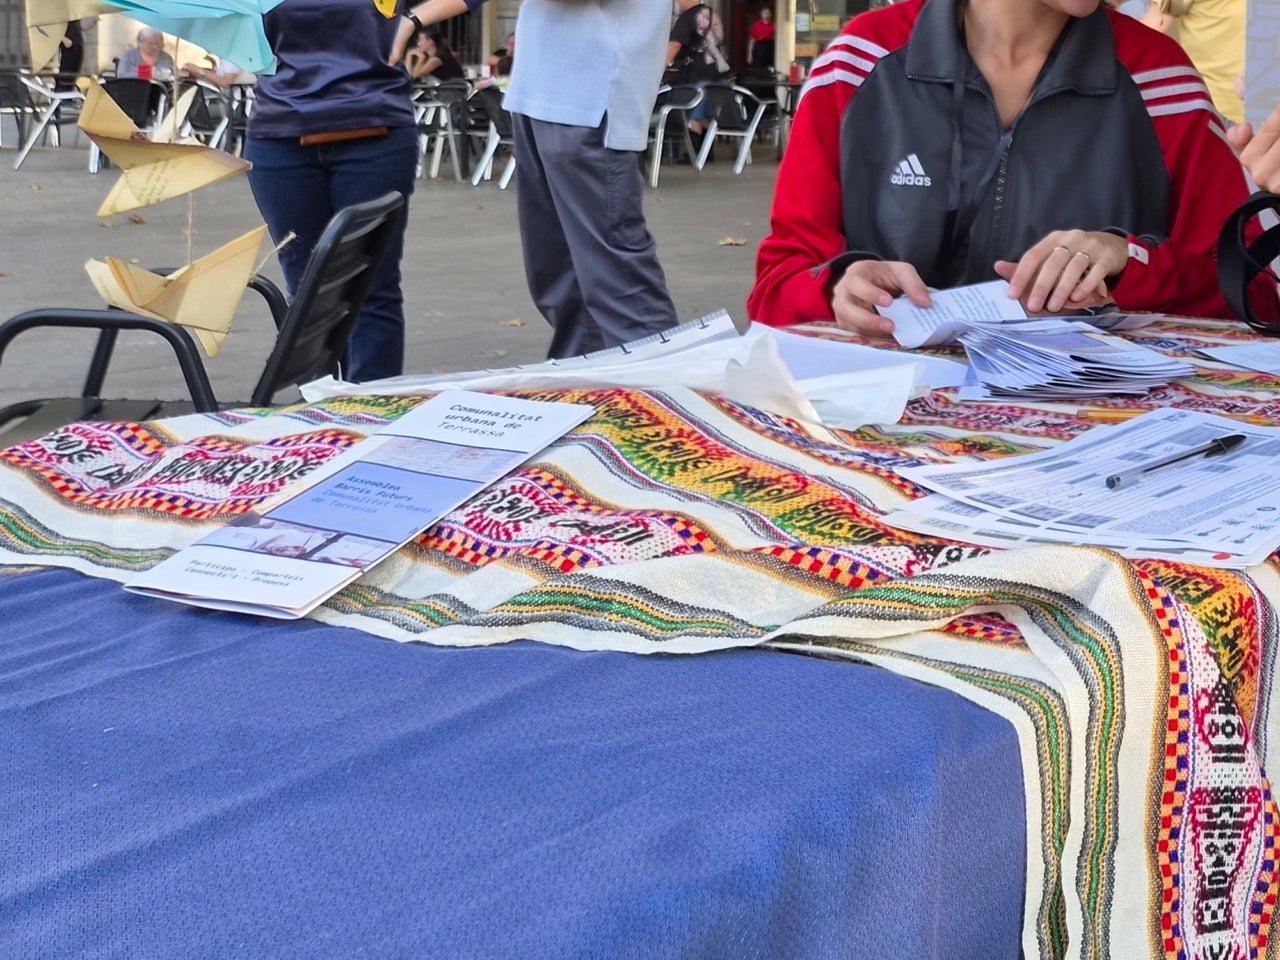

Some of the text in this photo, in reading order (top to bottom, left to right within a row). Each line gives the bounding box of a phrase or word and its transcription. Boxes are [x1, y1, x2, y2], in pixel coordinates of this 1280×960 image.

[891, 172, 932, 187] adidas
[449, 404, 543, 422] Comunalitat
[437, 421, 505, 437] Terrassa
[444, 413, 522, 430] urbana de
[334, 483, 371, 495] Barris
[346, 476, 401, 491] Assemblea
